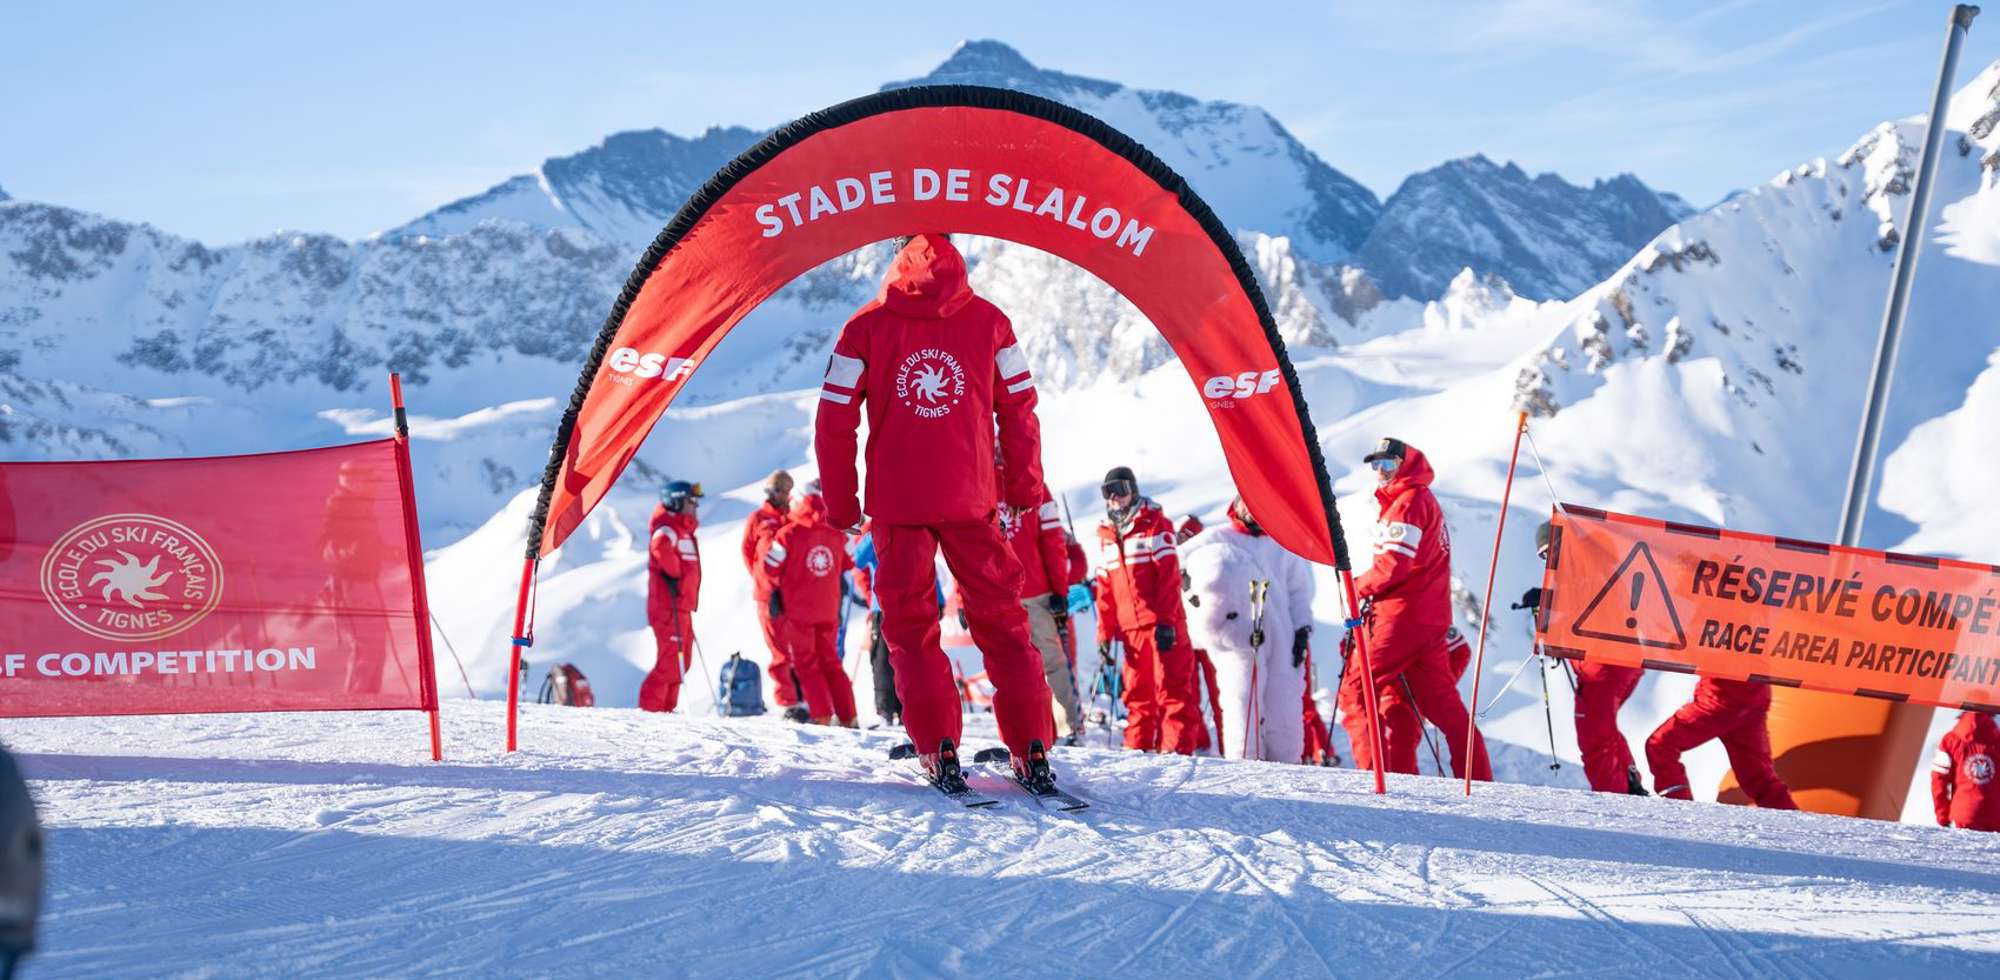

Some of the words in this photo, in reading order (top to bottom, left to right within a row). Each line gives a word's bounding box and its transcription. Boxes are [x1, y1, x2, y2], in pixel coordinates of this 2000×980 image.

[754, 169, 897, 238] STADE
[913, 168, 971, 202] DE
[984, 173, 1155, 257] SLALOM
[896, 364, 911, 398] ECOLE
[905, 352, 921, 367] DU
[921, 348, 939, 360] SKI
[914, 404, 950, 418] TIGNES
[58, 549, 88, 601] ECOLE
[77, 531, 108, 554] DU
[111, 526, 148, 543] SKI
[150, 530, 207, 600] FRANÇAIS
[97, 607, 174, 629] TIGNES
[1691, 554, 1863, 618] RÉSERVÉ
[1871, 584, 2000, 636] COMPÉ
[0, 653, 26, 677] F
[36, 647, 316, 676] COMPETITION
[1698, 619, 1770, 655] RACE
[1770, 630, 1840, 666] AREA
